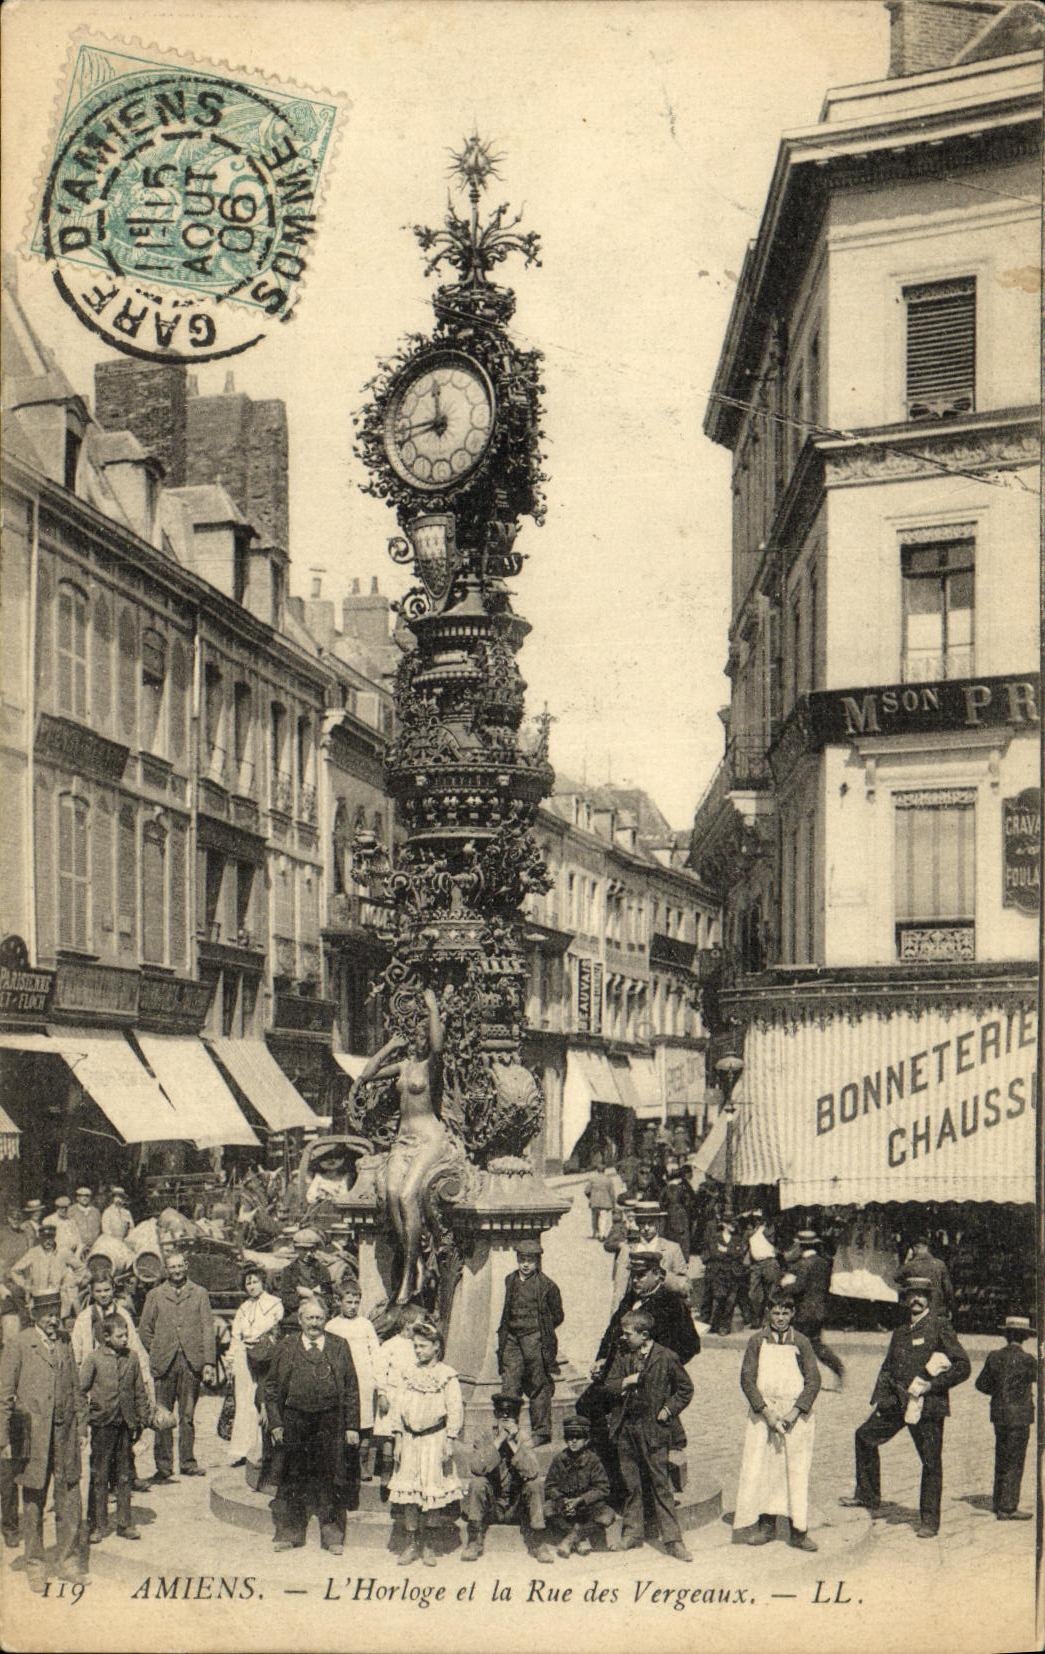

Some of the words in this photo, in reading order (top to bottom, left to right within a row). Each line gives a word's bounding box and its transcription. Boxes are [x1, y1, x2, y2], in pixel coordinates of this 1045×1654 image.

[58, 90, 225, 251] D'AMIENS
[182, 166, 217, 276] AOUT
[218, 194, 257, 253] 06
[251, 135, 317, 314] SOMME
